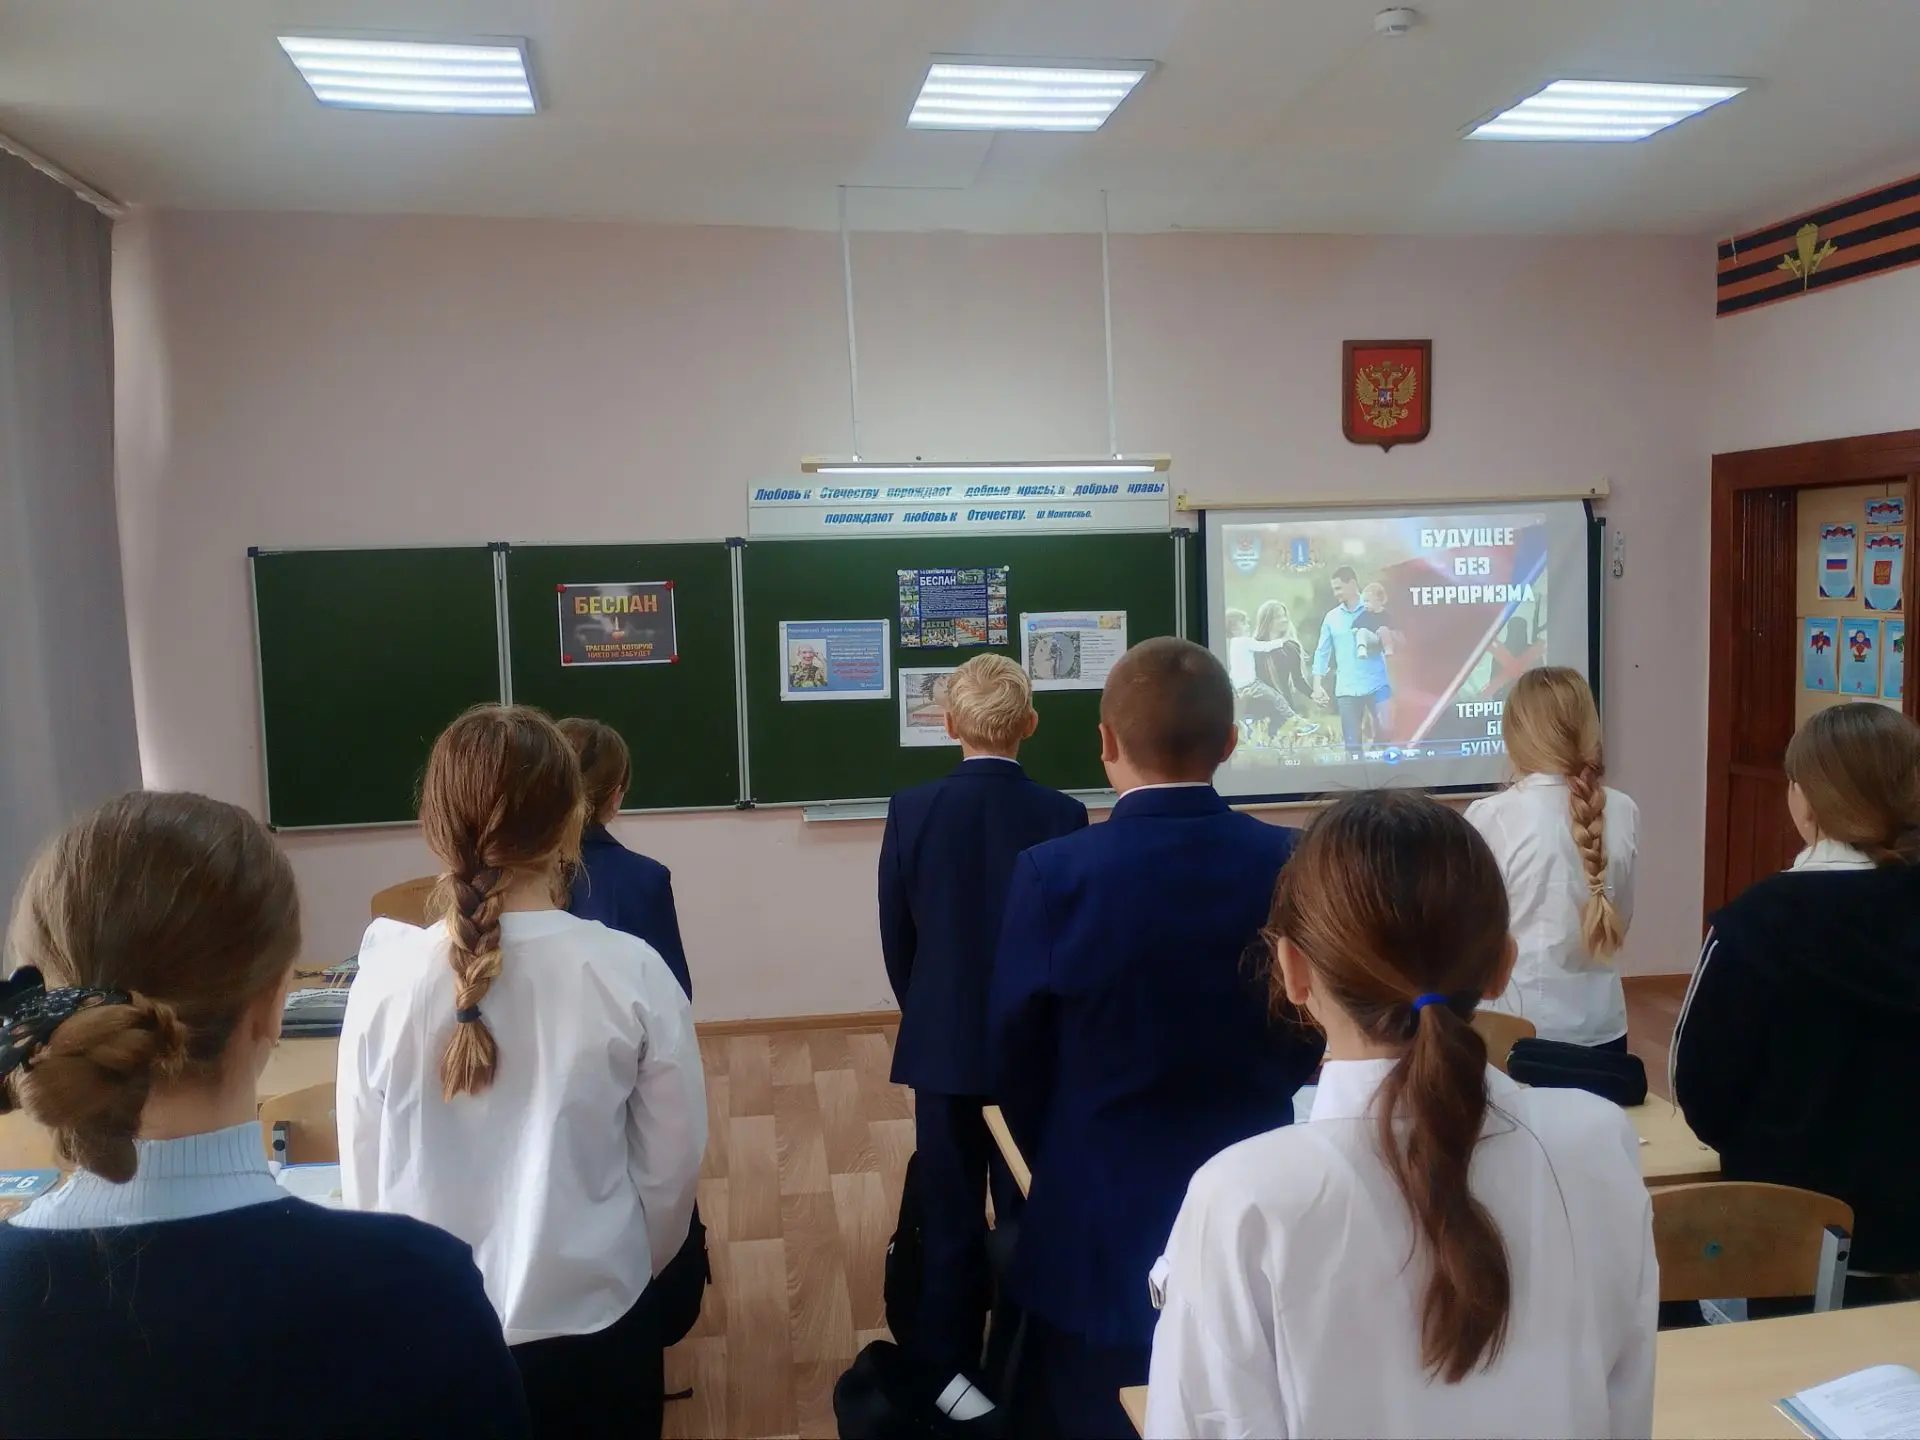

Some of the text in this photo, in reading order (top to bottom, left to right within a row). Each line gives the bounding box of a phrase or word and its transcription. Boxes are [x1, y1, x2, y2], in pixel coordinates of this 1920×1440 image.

[755, 488, 801, 500] Любовь
[803, 488, 812, 499] к
[819, 487, 879, 499] Отечеству
[886, 486, 952, 499] порождает
[964, 484, 1010, 497] добрые
[1073, 483, 1119, 496] добрые
[1127, 482, 1165, 494] нравы
[825, 511, 894, 524] порождают
[902, 510, 947, 522] любовь
[949, 511, 958, 522] к
[967, 509, 1026, 521] Отечеству.
[1421, 527, 1514, 548] БУДУЩЕЕ
[1454, 556, 1490, 576] БЕЗ
[919, 576, 956, 586] БЕСЛАН
[1409, 583, 1535, 605] ТЕРРОРИЗМА
[575, 595, 657, 614] БЕСЛАН
[1456, 701, 1504, 718] ТЕРРО
[1461, 740, 1505, 757] БУДУ
